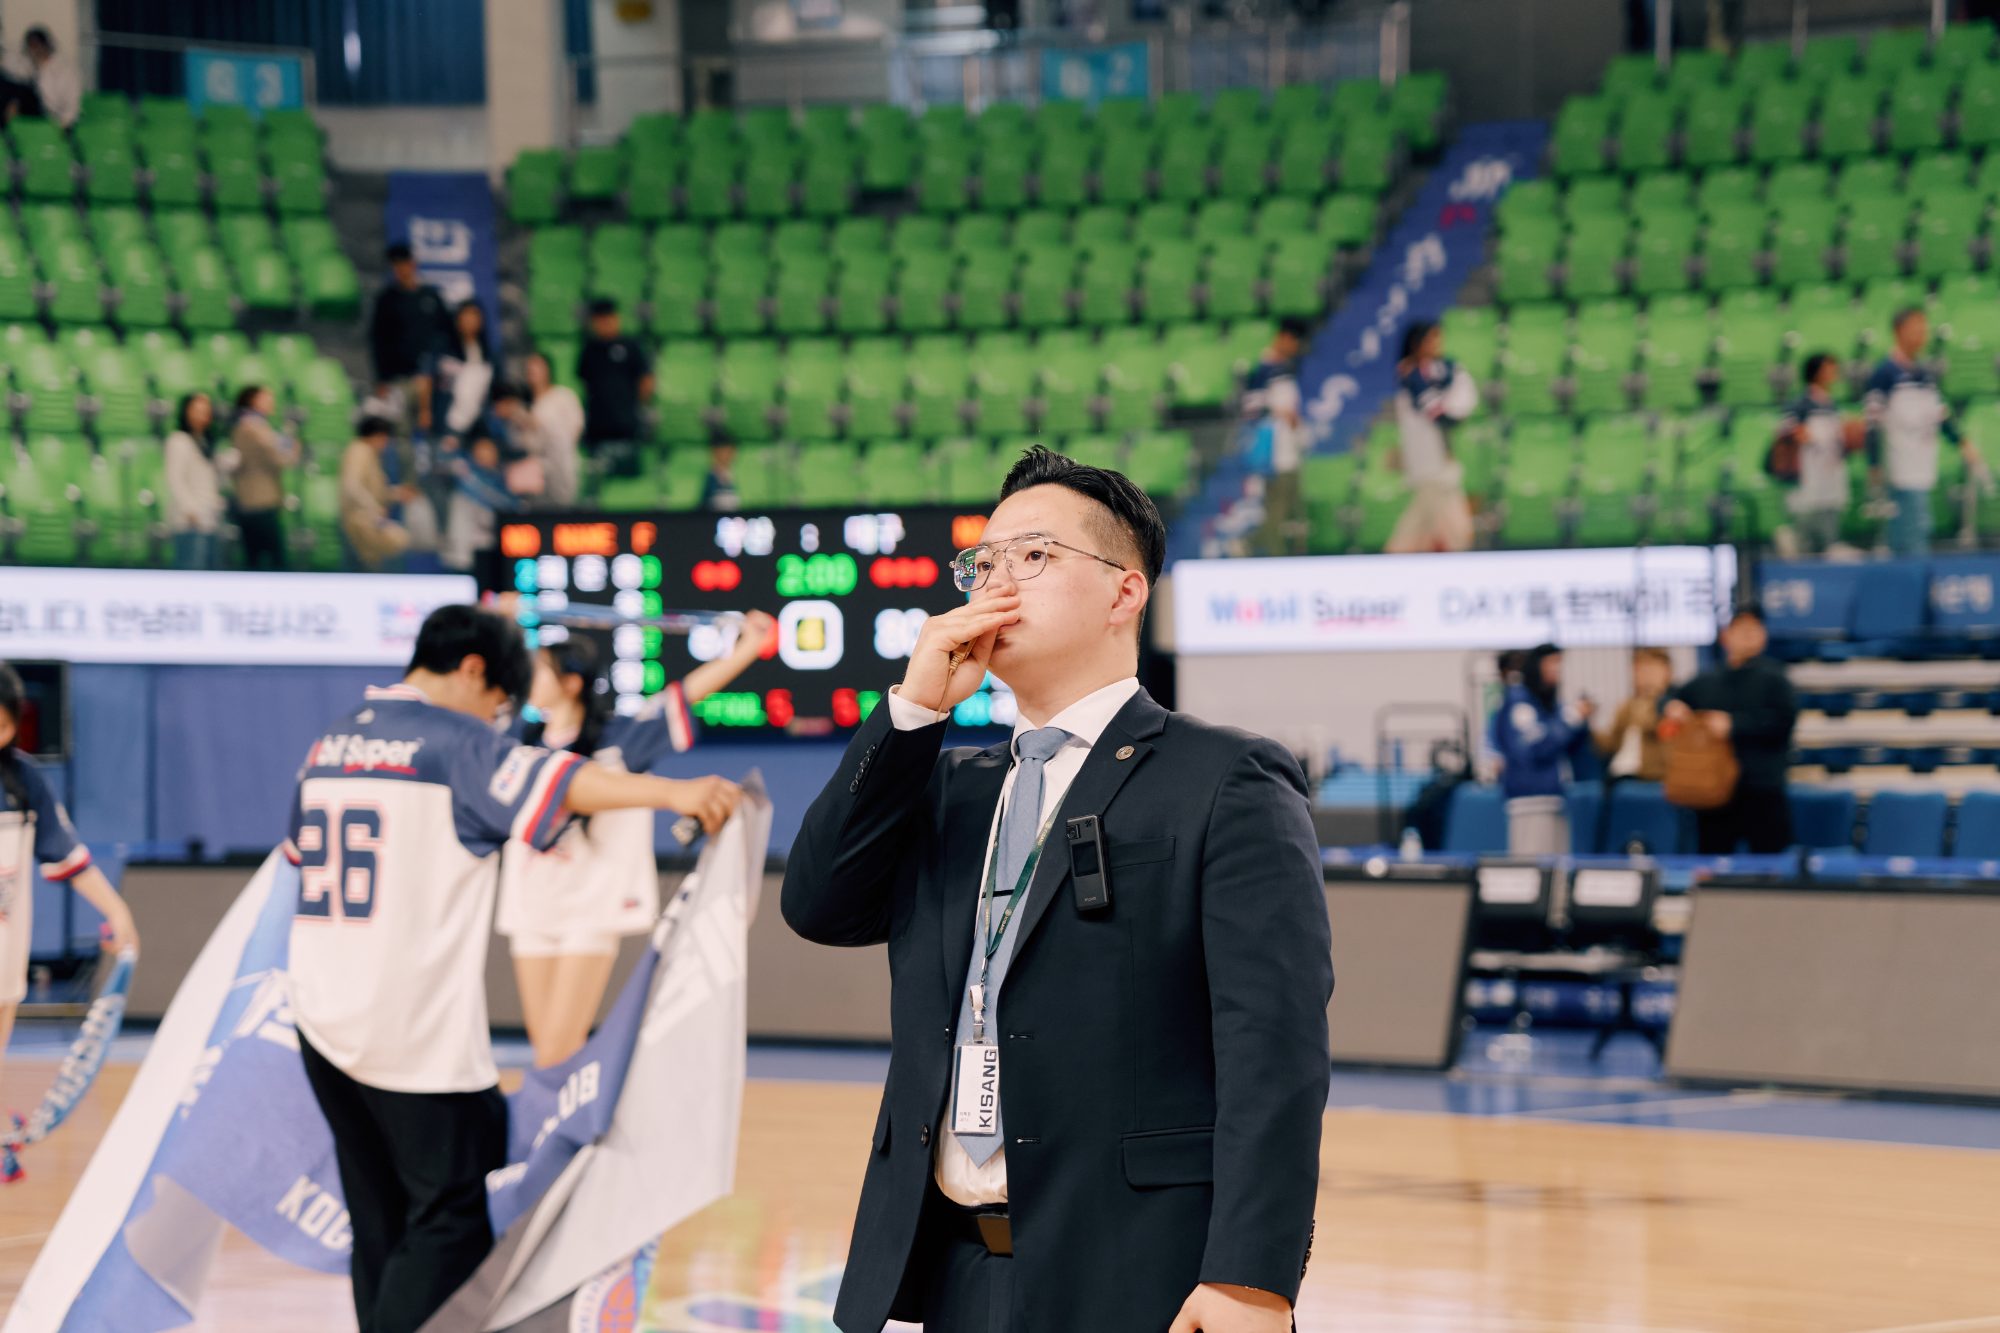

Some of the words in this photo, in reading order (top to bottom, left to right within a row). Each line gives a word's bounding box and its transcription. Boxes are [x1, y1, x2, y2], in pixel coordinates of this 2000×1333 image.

[1207, 592, 1298, 622] Mobil
[1311, 593, 1404, 625] Super
[294, 804, 386, 923] 26
[978, 1049, 998, 1128] KISANG
